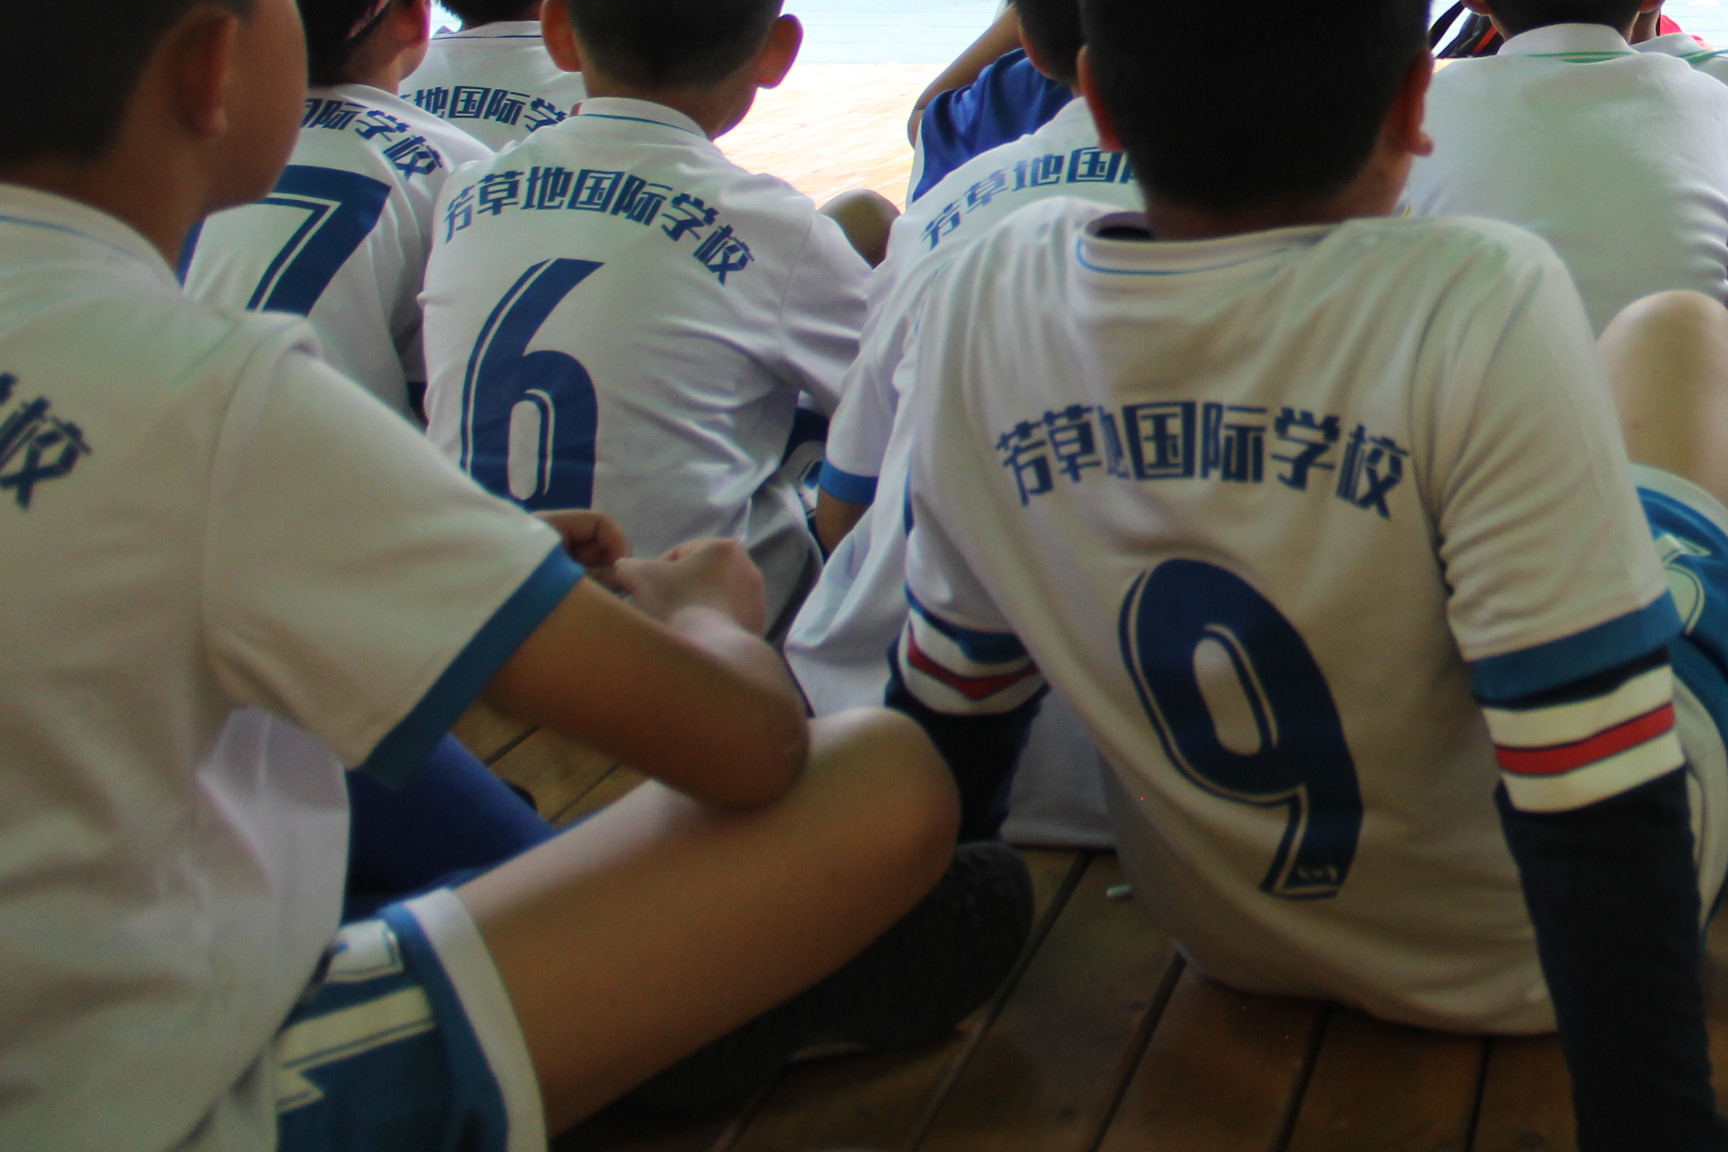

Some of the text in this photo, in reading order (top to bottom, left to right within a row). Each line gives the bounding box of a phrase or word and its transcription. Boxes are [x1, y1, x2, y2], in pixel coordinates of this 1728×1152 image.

[246, 165, 392, 315] 7
[443, 168, 756, 285] 芳草地国际学校
[460, 257, 605, 512] 6
[1118, 558, 1364, 900] 9
